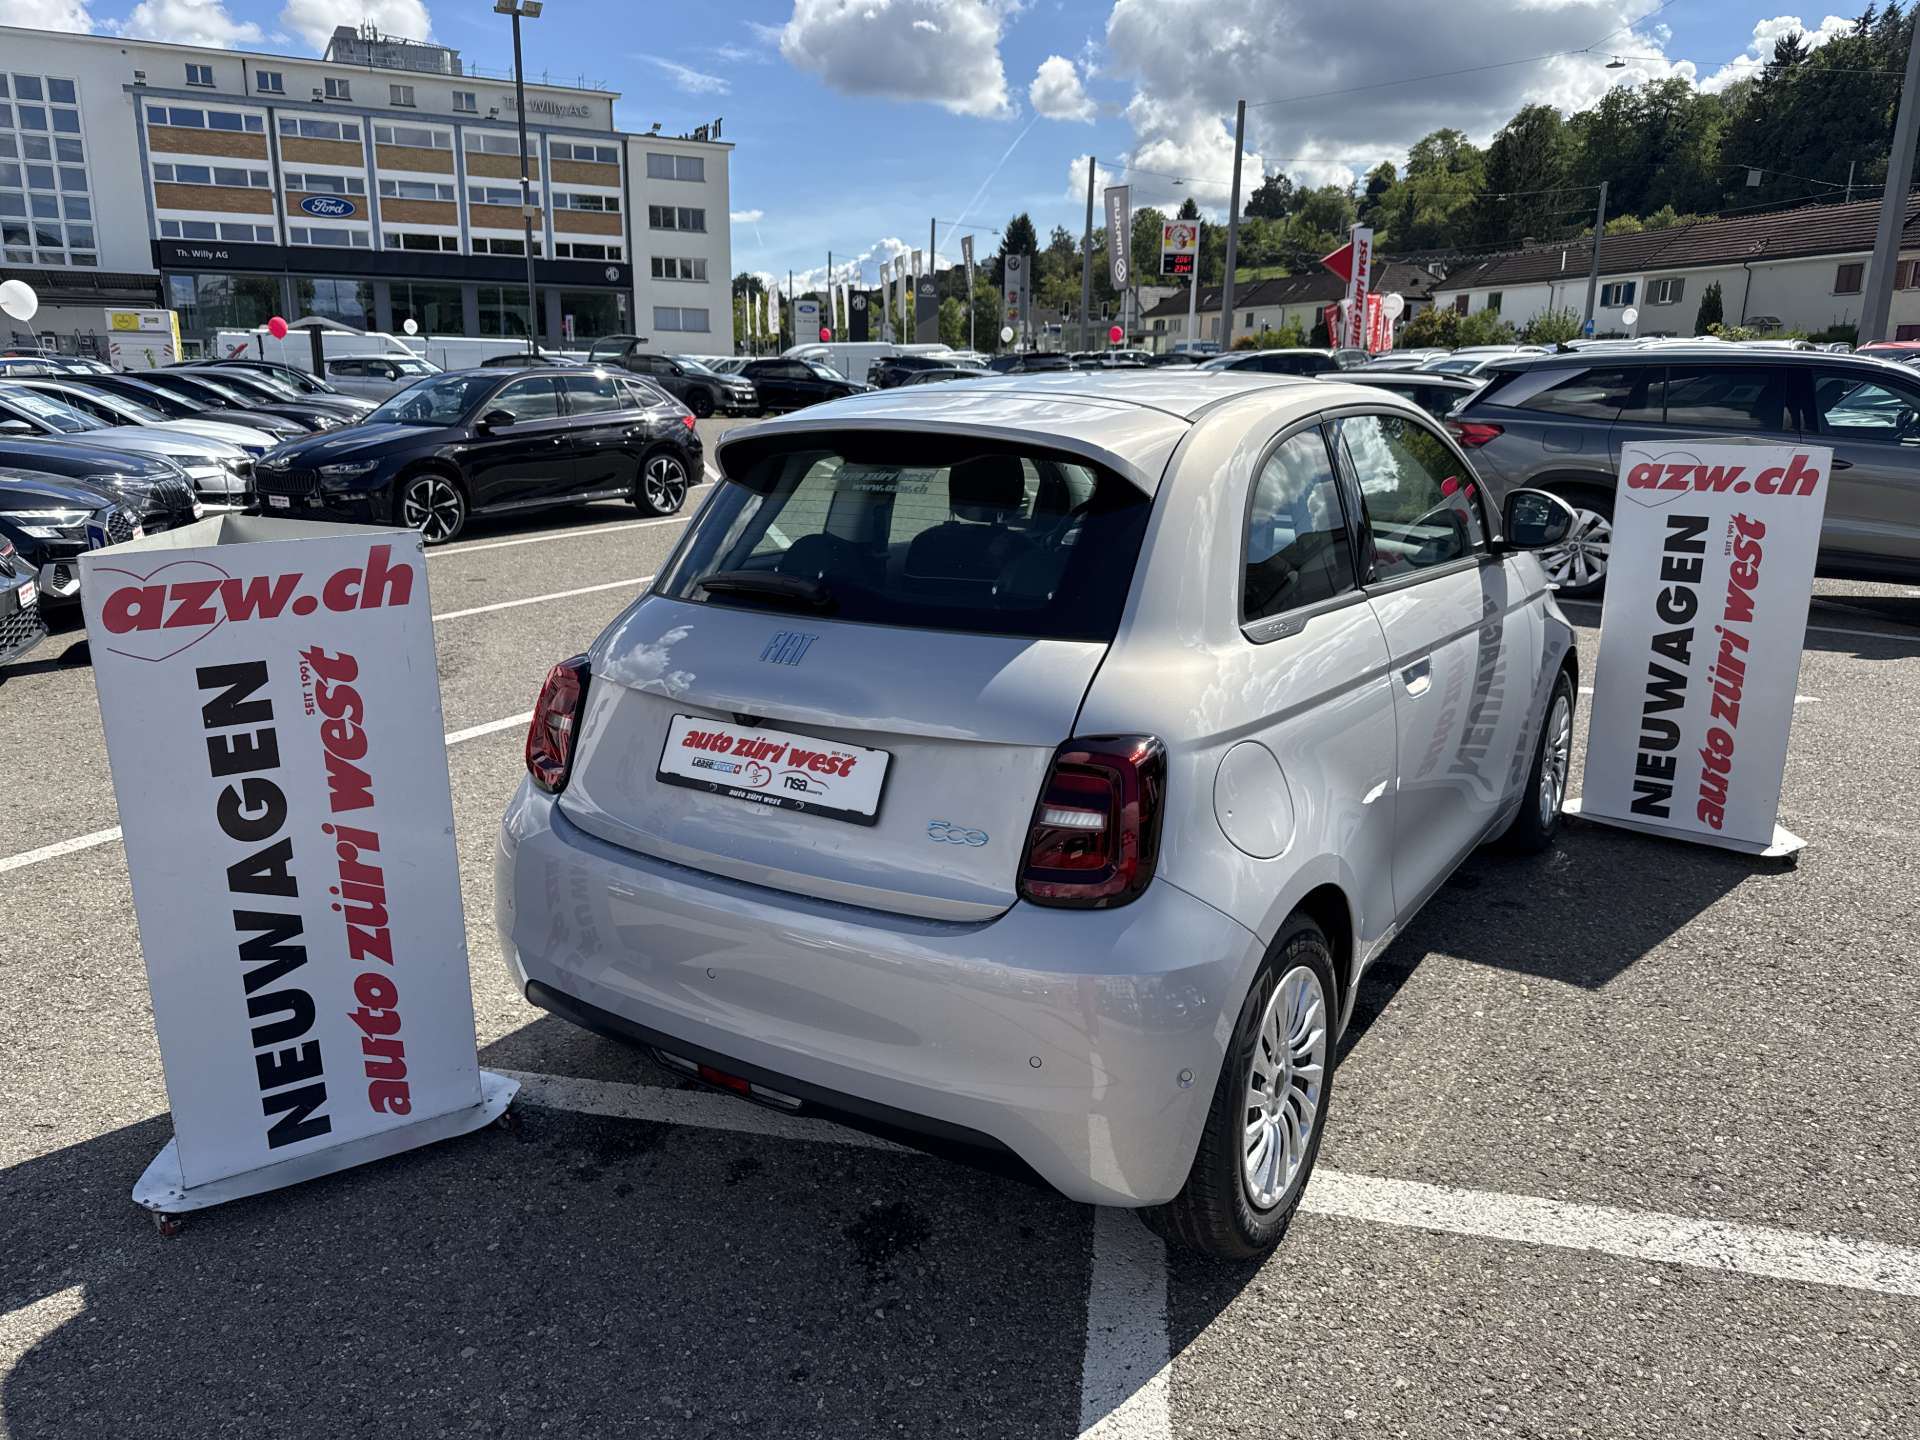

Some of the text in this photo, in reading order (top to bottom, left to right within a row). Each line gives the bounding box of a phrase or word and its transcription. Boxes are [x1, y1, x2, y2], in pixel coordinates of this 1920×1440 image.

[311, 198, 344, 214] Ford
[176, 249, 229, 260] Th. Willy AG
[1627, 454, 1820, 496] azw.ch
[101, 544, 414, 634] azw.ch
[759, 631, 820, 666] FIAT
[1630, 514, 1710, 819] NEUWAGEN
[299, 660, 315, 716] SEIT 1991
[1697, 512, 1767, 831] auto züri west
[681, 729, 857, 778] auto züri west
[728, 789, 746, 798] auto
[763, 796, 782, 805] west
[783, 775, 808, 792] nsa
[927, 820, 989, 848] 500
[299, 645, 412, 1116] auto züri west
[196, 660, 331, 1149] NEUWAGEN
